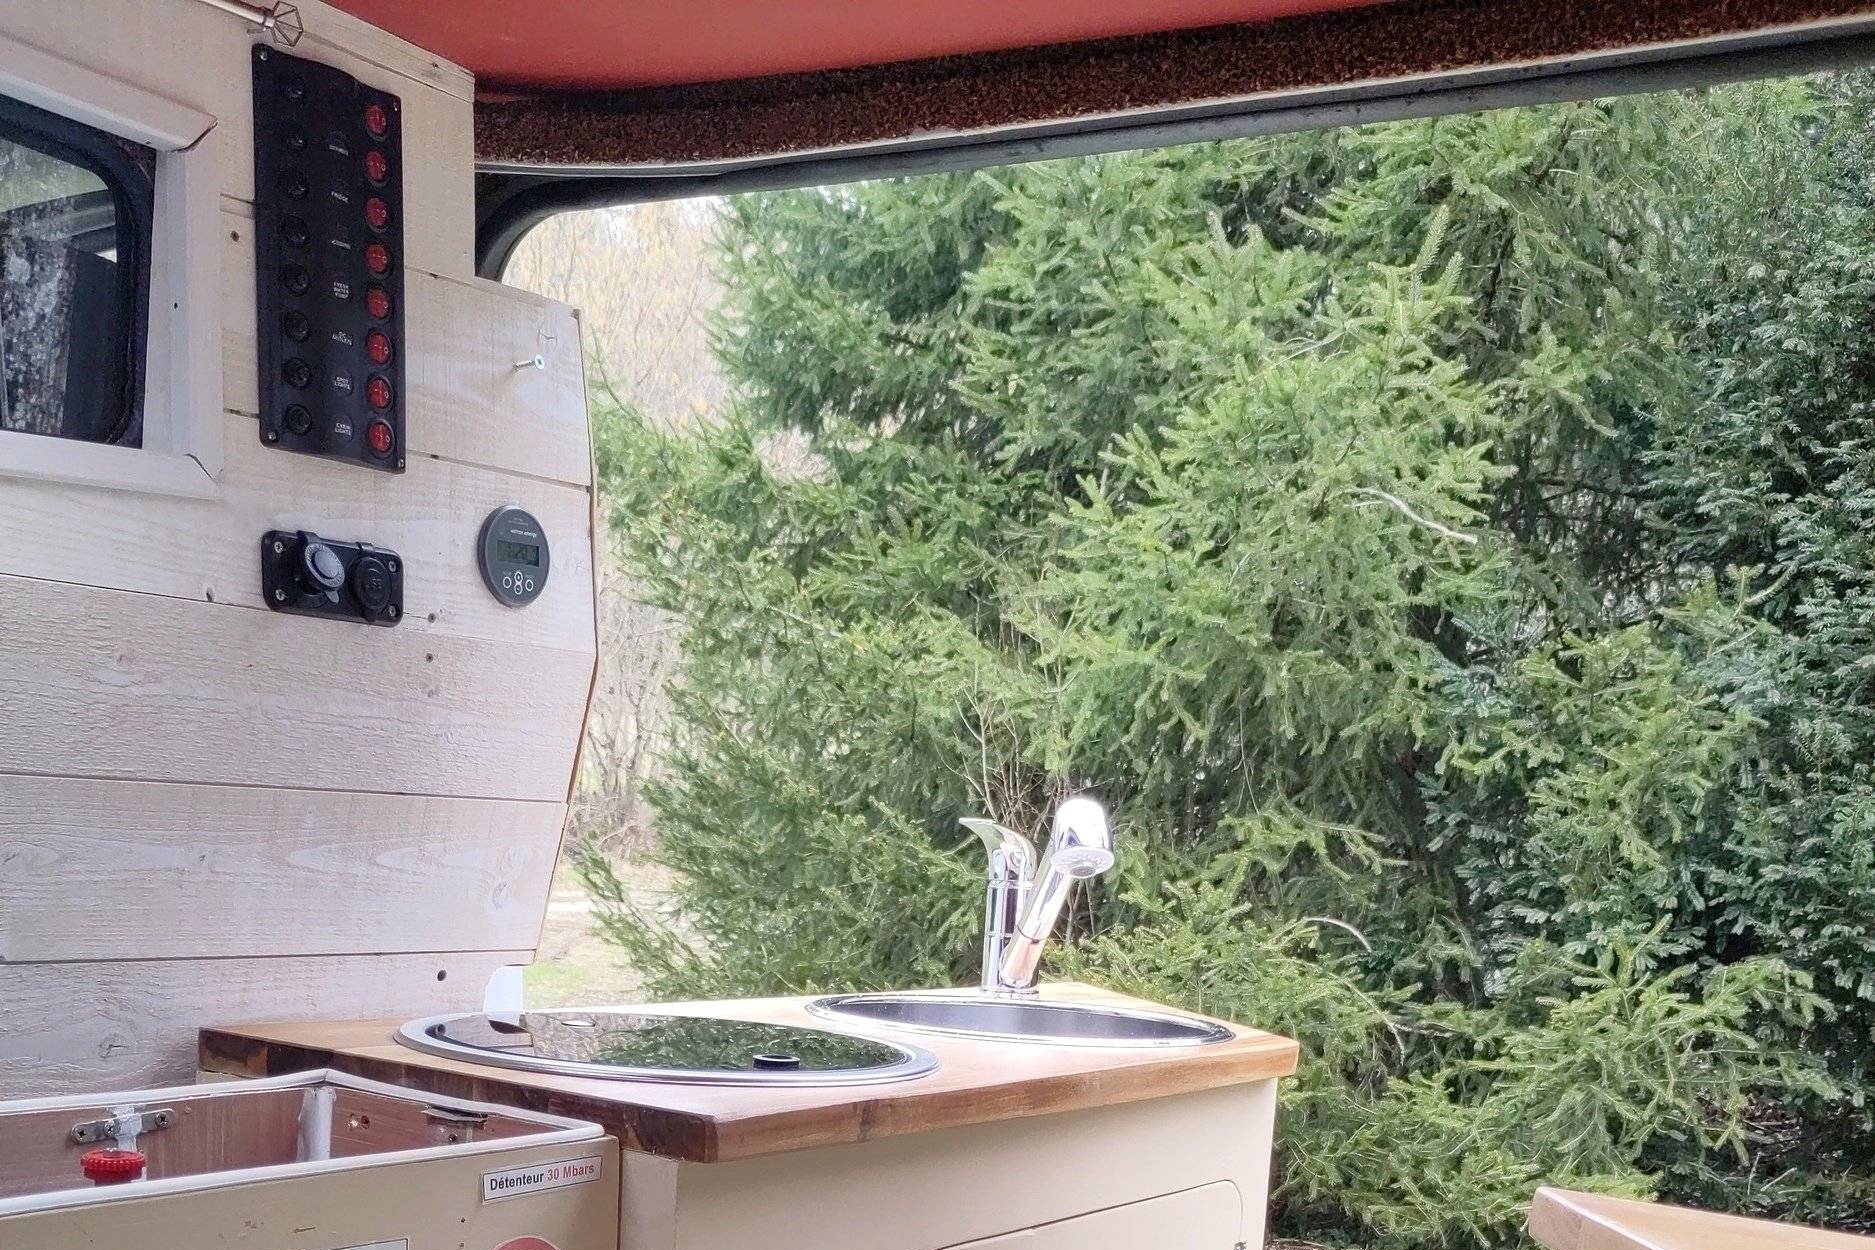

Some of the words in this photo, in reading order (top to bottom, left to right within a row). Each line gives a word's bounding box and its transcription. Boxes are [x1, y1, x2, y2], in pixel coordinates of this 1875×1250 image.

[490, 1172, 545, 1191] Détenteur
[547, 1168, 560, 1181] 30
[563, 1163, 595, 1179] Mbars
